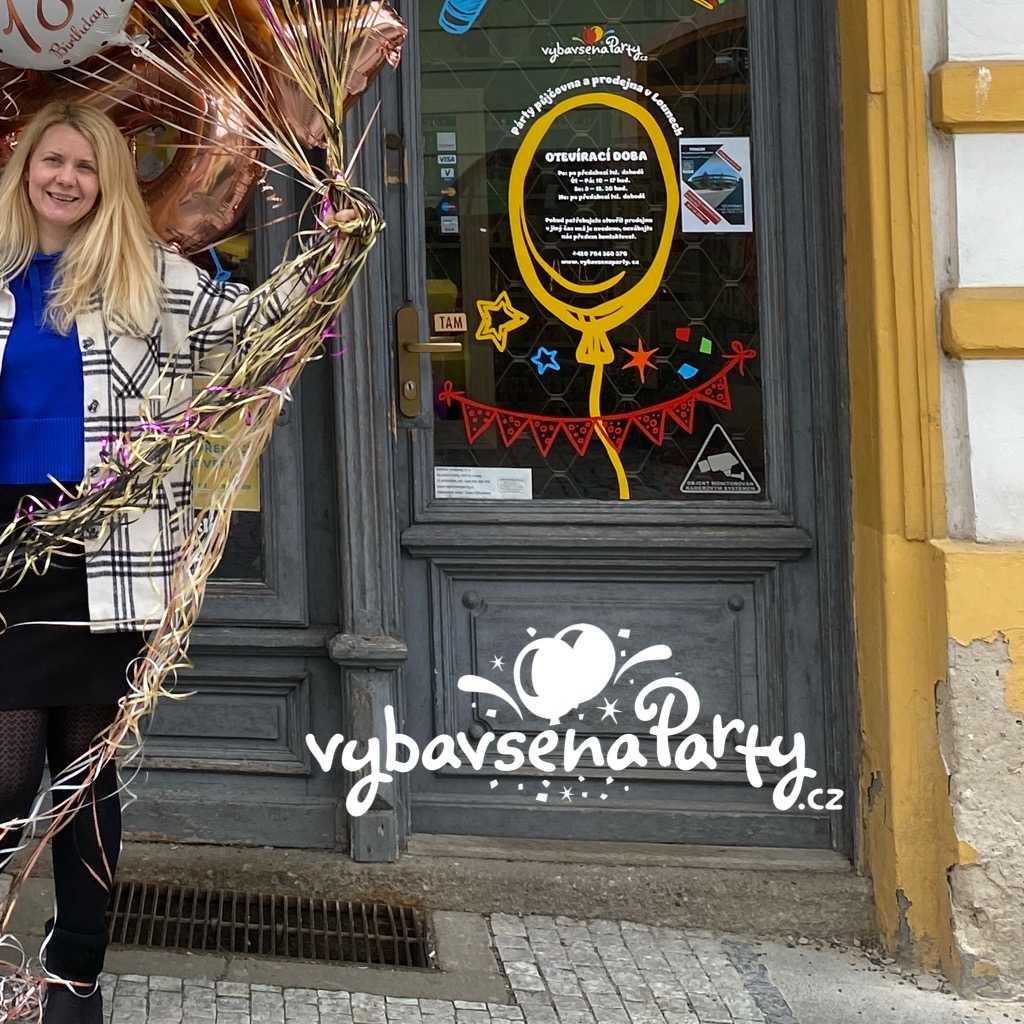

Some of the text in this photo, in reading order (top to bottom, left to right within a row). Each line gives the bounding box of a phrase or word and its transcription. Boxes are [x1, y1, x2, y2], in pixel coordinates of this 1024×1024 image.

[47, 5, 110, 60] Birthday
[510, 106, 536, 136] Párty
[533, 79, 582, 113] půjčovna
[582, 77, 590, 86] a
[591, 74, 645, 94] prodejna
[439, 155, 455, 163] VISA
[544, 147, 648, 163] OTEVÍRACÍ DOBA
[439, 316, 463, 329] TAM
